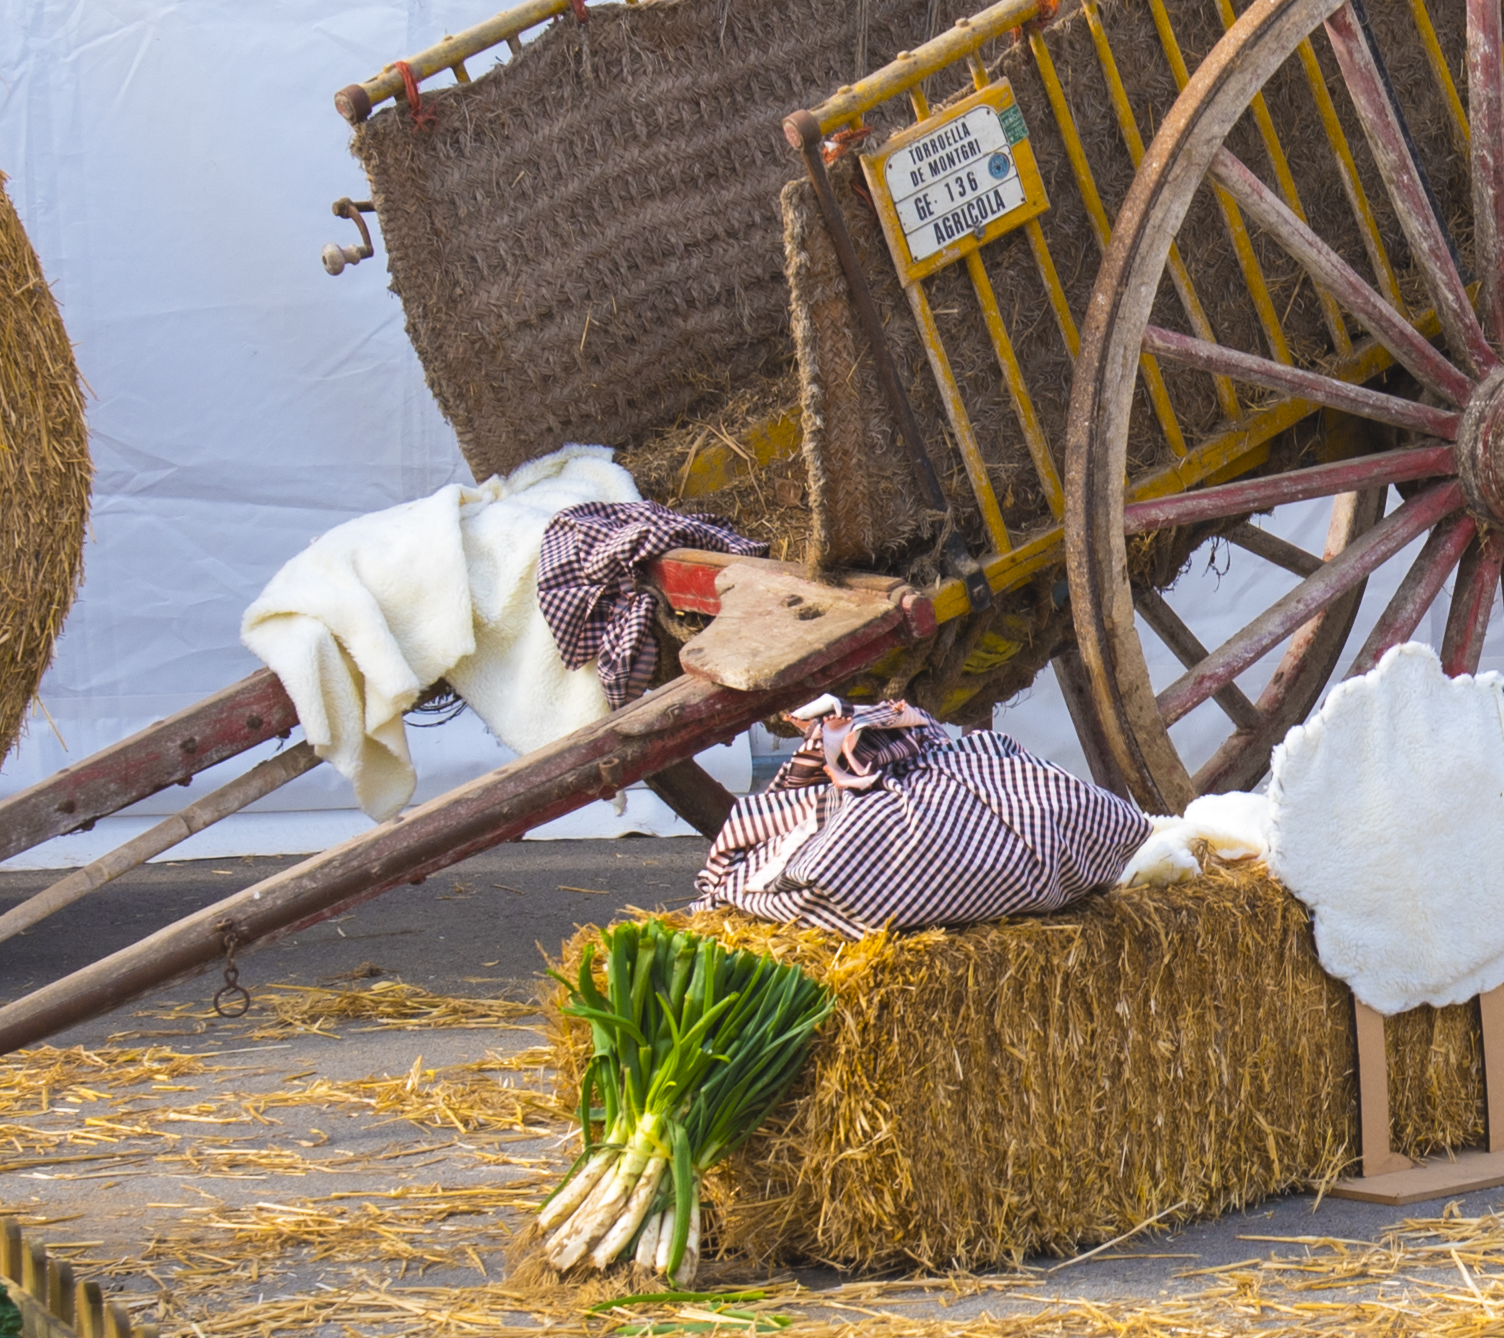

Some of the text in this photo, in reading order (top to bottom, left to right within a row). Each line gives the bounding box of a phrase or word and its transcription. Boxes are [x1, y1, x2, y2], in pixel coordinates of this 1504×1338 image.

[908, 122, 971, 165] TORROELLA
[910, 167, 925, 187] DE
[928, 138, 981, 178] MONTGRI
[944, 171, 978, 202] 136
[933, 189, 1006, 245] AGRICOLA
